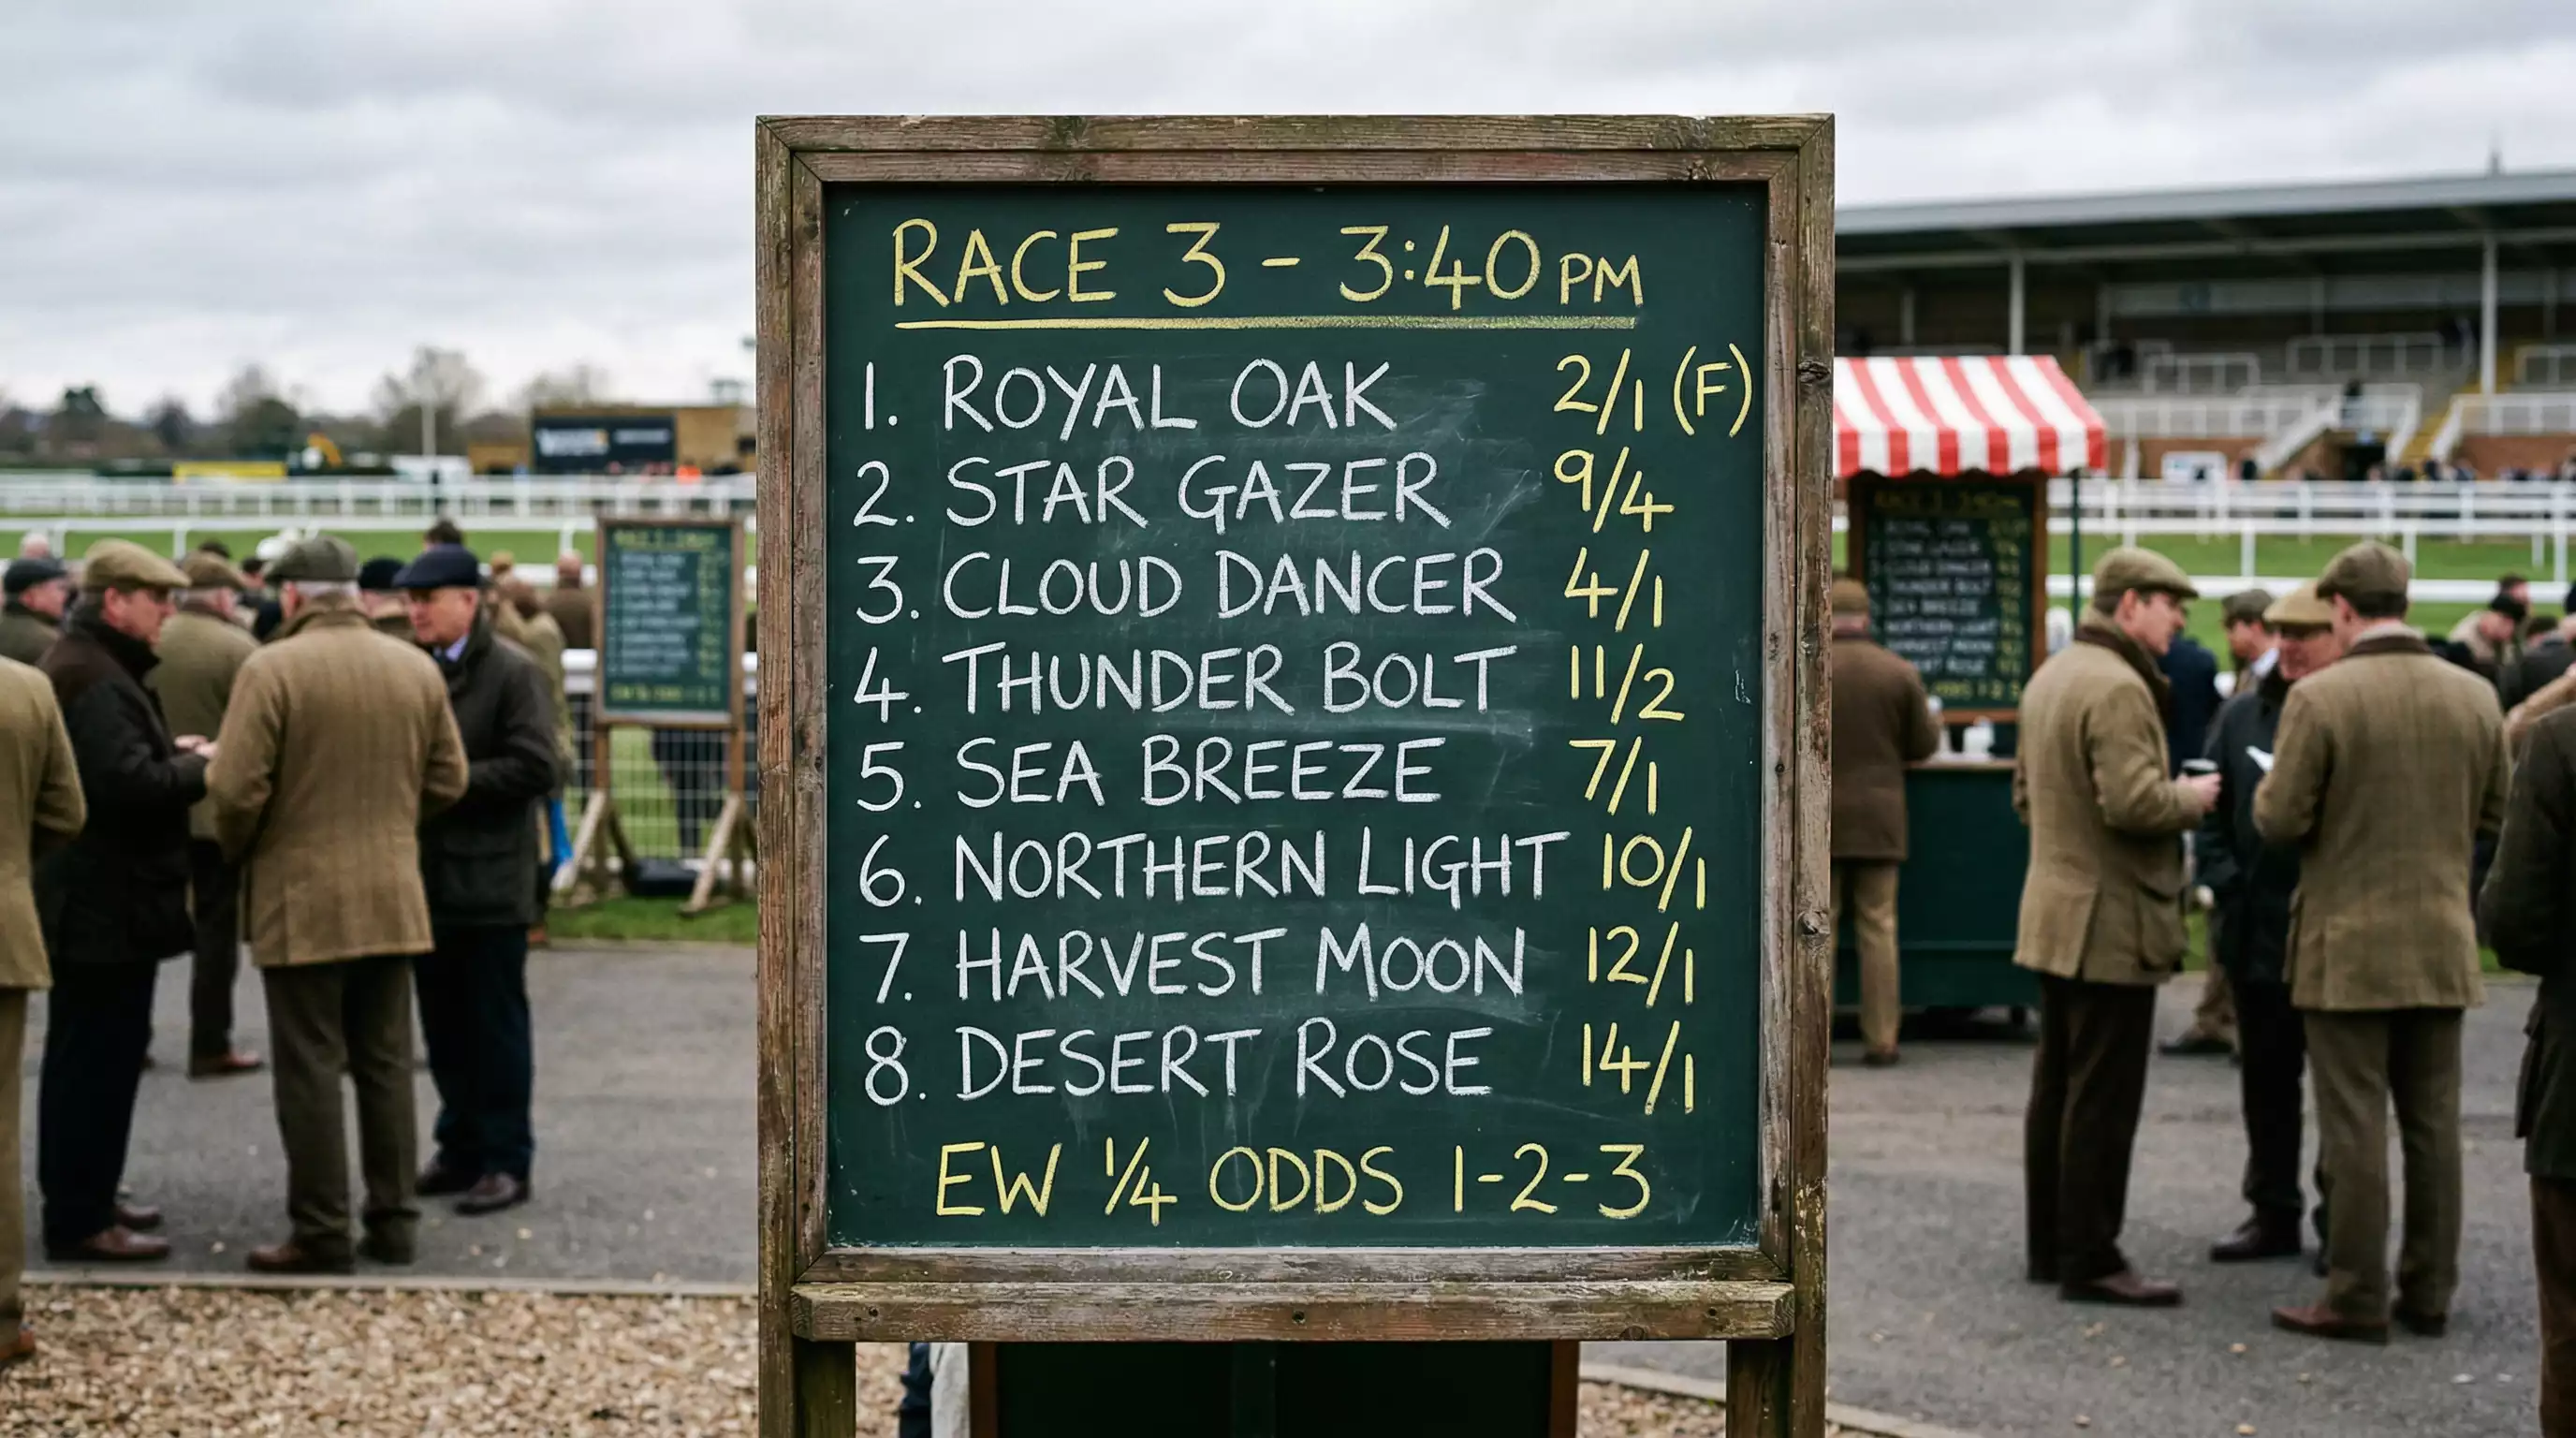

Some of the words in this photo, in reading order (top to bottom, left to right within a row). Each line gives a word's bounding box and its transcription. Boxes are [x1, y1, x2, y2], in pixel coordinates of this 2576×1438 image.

[892, 218, 1120, 308] RACE
[1163, 222, 1226, 308] 3
[1339, 224, 1542, 311] 3:40
[1559, 253, 1644, 307] PM
[865, 361, 898, 431] 1.
[943, 354, 1198, 442] ROYAL
[1230, 358, 1398, 432] OAK
[1553, 347, 1644, 436] 2/1
[1673, 343, 1752, 438] (F)
[853, 460, 915, 527] 2.
[946, 455, 1149, 529] STAR
[1178, 451, 1452, 536] GAZER
[1553, 446, 1675, 534] 9/4
[856, 555, 920, 624] 3.
[943, 550, 1183, 619] CLOUD
[1214, 547, 1517, 624] DANCER
[1563, 546, 1663, 633] 4/1
[853, 646, 922, 724] 4.
[941, 641, 1295, 717] THUNDER
[1322, 640, 1518, 714] BOLT
[1571, 642, 1686, 726] 11/2
[856, 741, 922, 812] 5.
[956, 737, 1105, 809] SEA
[1140, 734, 1446, 807] BREEZE
[1568, 735, 1658, 816] 7/1
[859, 834, 922, 907] 6.
[955, 829, 1325, 902] NORTHERN
[1357, 826, 1572, 912] LIGHT
[1603, 826, 1705, 914] 10/1
[858, 932, 913, 1005] 7.
[955, 927, 1288, 1003] HARVEST
[1315, 921, 1526, 1003] MOON
[1588, 920, 1693, 1008] 12/1
[865, 1025, 927, 1107] 8.
[955, 1024, 1263, 1101] DESERT
[1296, 1016, 1494, 1099] ROSE
[1582, 1020, 1694, 1116] 14/1
[936, 1141, 1062, 1217] EW
[1208, 1146, 1404, 1216] ODDS
[1454, 1142, 1651, 1220] 1-2-3
